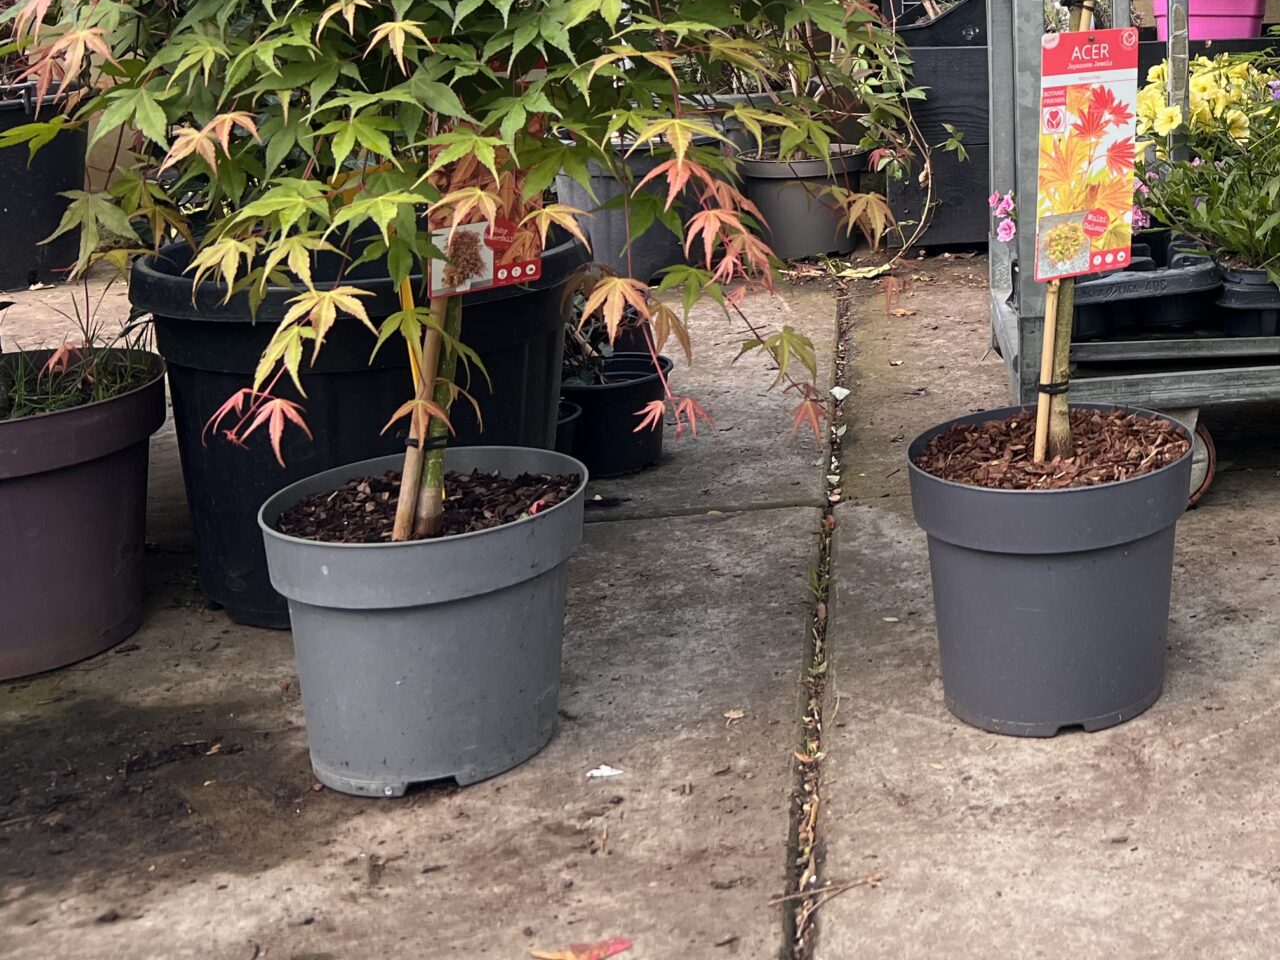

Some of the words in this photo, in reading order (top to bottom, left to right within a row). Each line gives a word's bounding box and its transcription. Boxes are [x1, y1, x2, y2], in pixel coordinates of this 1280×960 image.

[1071, 43, 1110, 61] ACER
[1087, 214, 1107, 223] Multi
[1083, 223, 1105, 233] Colour
